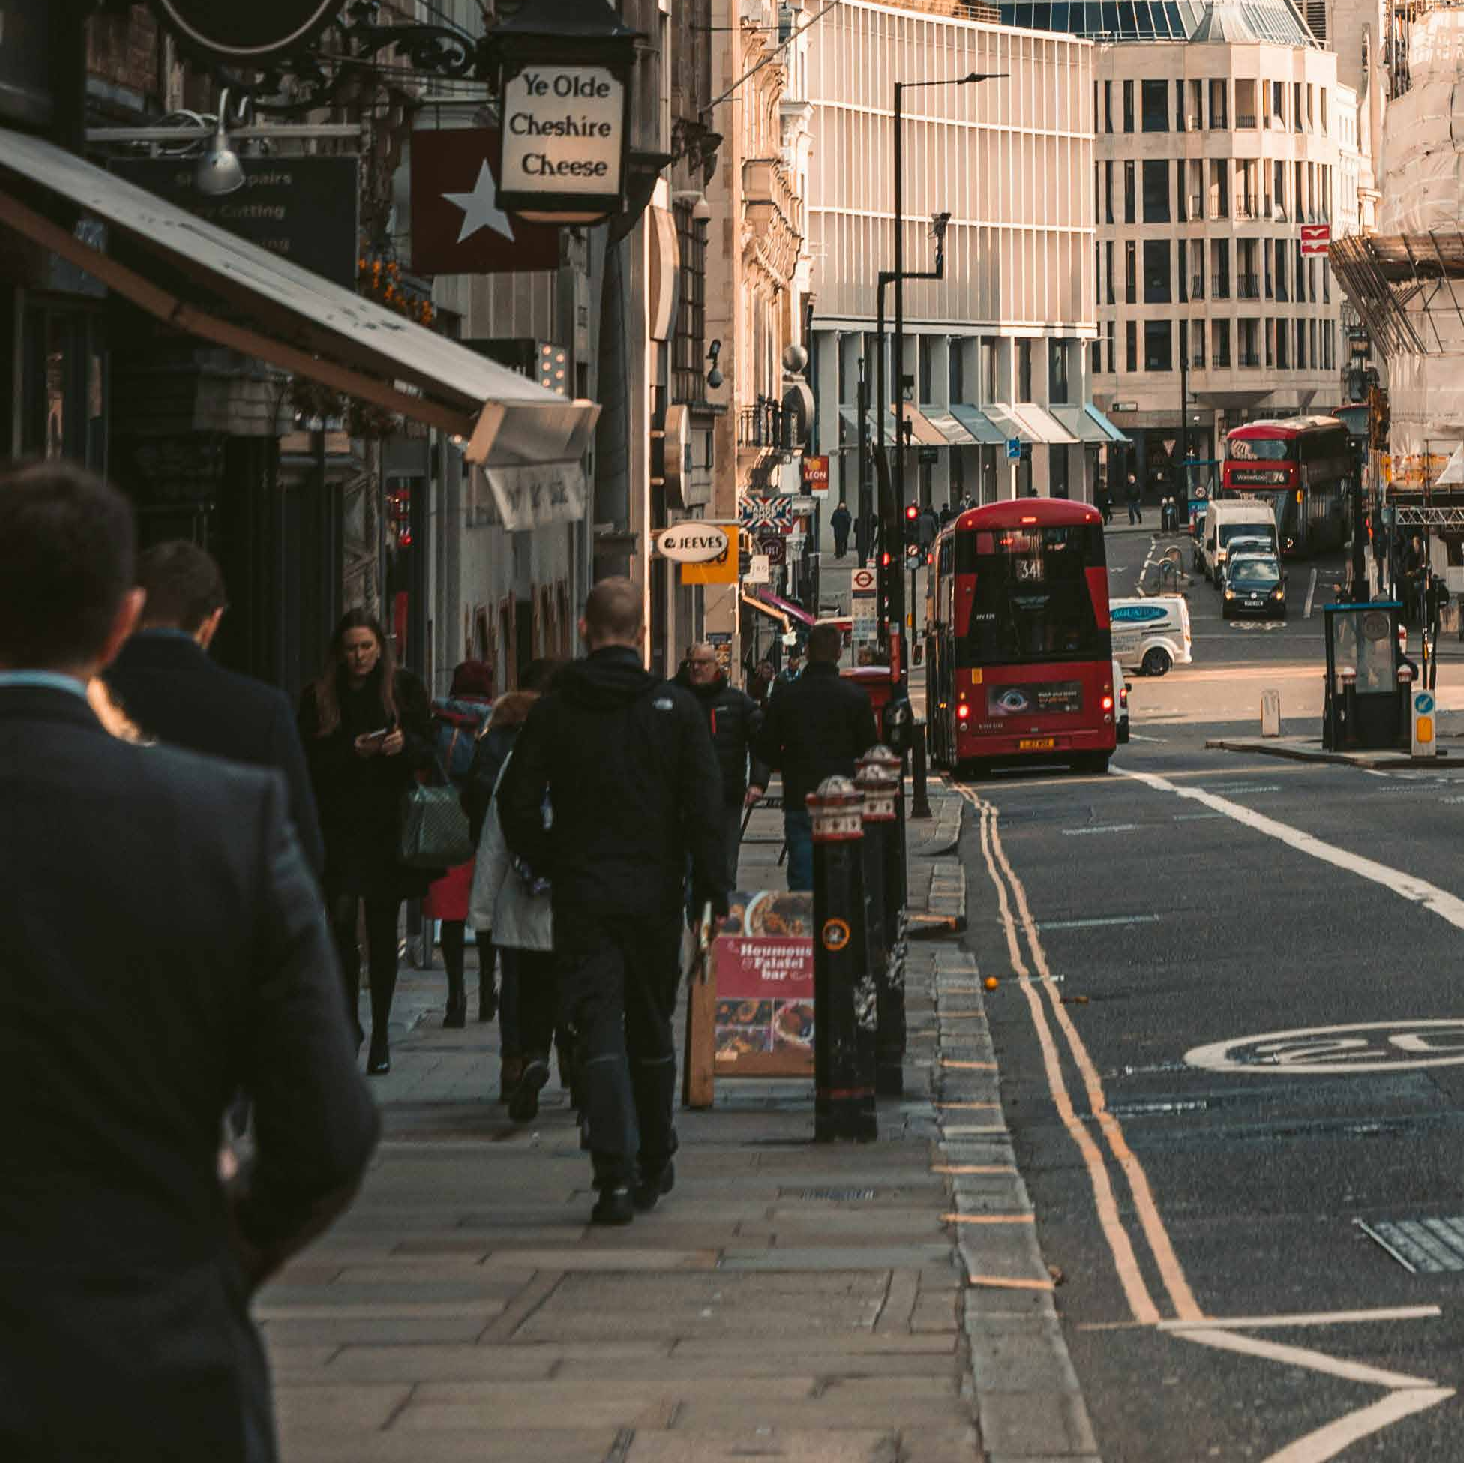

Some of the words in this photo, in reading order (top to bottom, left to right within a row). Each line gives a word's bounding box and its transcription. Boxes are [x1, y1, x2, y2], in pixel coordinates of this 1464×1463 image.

[523, 73, 548, 96] Ye
[553, 75, 611, 98] Olde
[510, 112, 611, 137] Cheshire
[522, 153, 608, 176] Cheese
[804, 471, 828, 480] LEON
[679, 536, 723, 549] JEEVES
[1020, 559, 1041, 578] 341
[741, 943, 813, 956] Houmous
[753, 957, 804, 969] Falafel
[762, 968, 788, 980] bar
